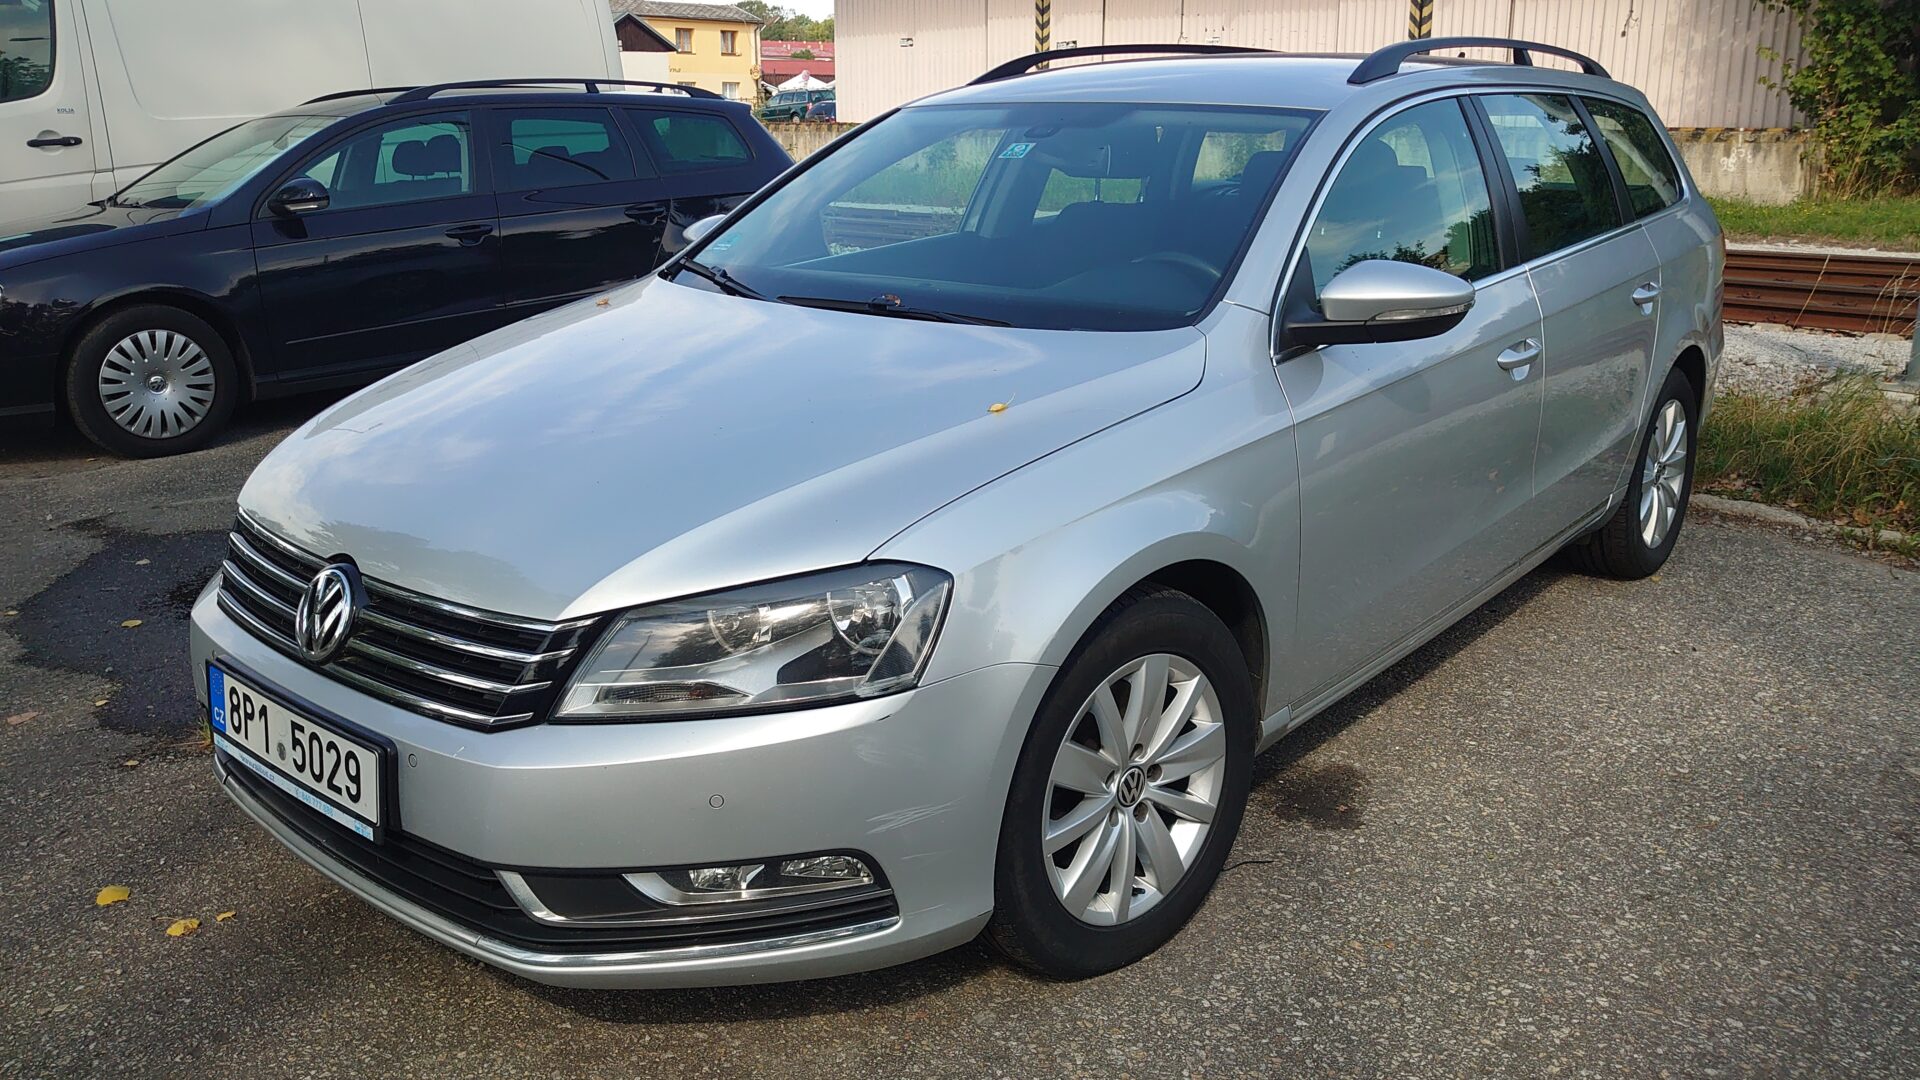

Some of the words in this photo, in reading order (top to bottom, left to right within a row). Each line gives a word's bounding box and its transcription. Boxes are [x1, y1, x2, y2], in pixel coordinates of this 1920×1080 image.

[214, 706, 225, 724] CZ
[229, 686, 270, 754] 8P1
[290, 719, 361, 804] 5029
